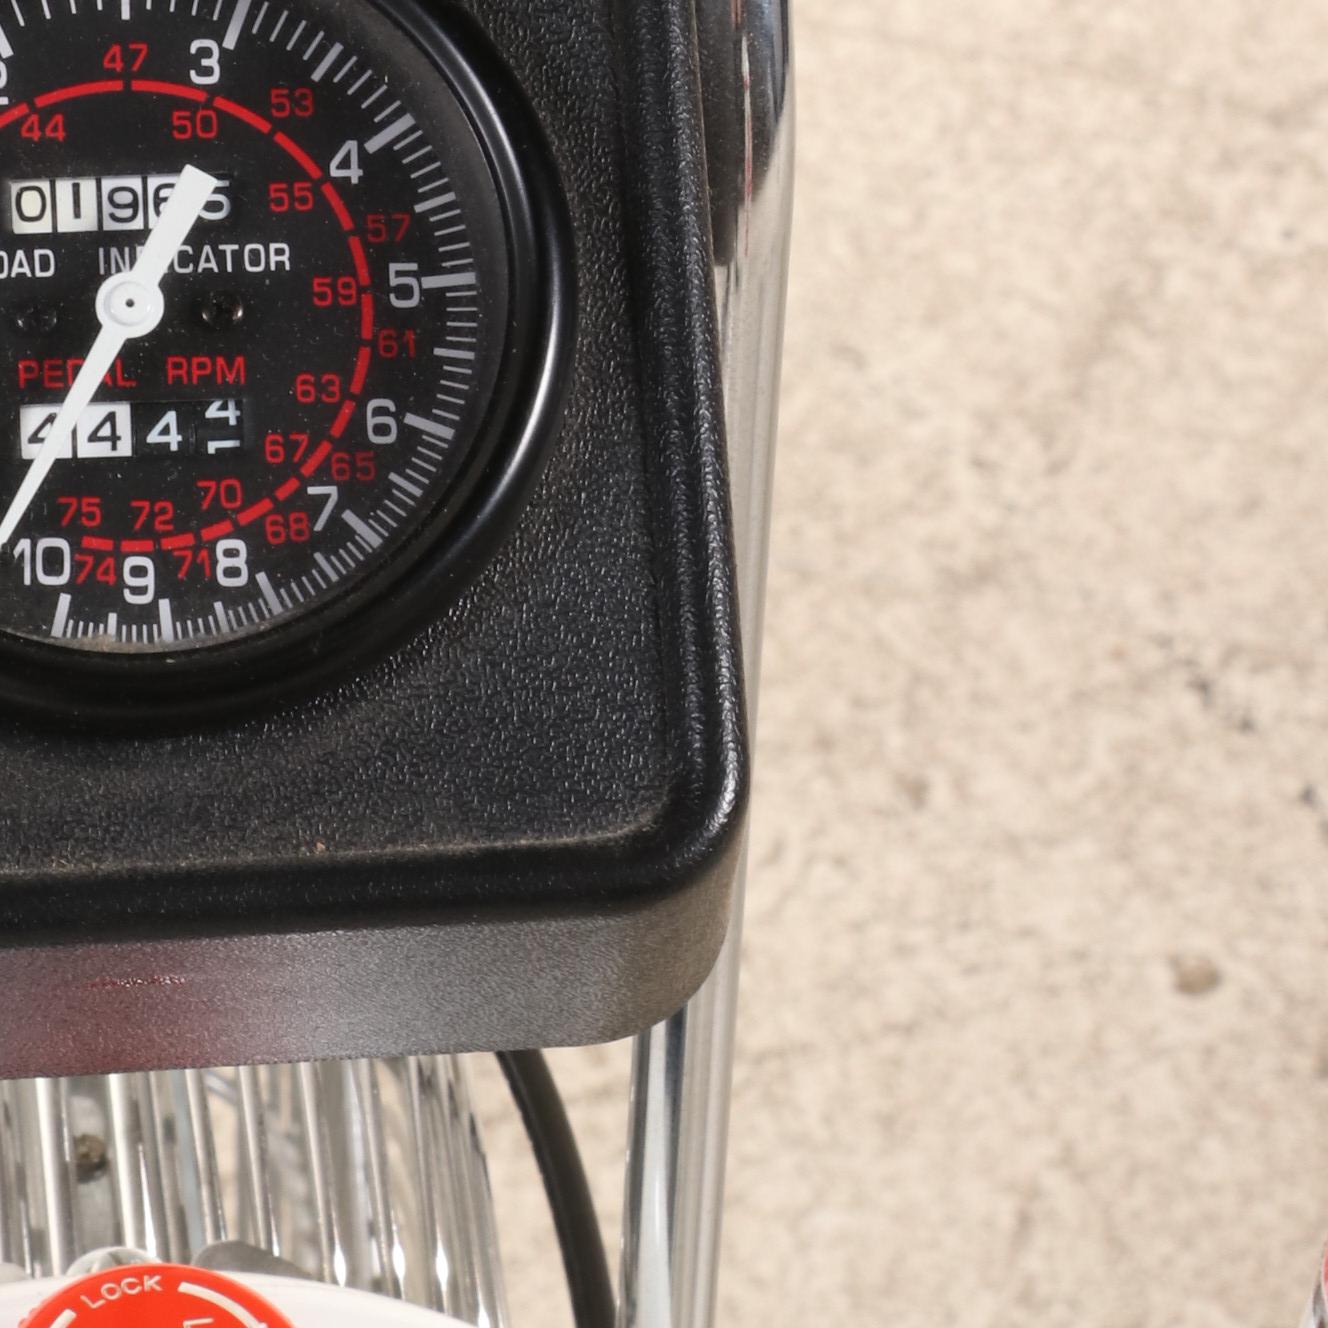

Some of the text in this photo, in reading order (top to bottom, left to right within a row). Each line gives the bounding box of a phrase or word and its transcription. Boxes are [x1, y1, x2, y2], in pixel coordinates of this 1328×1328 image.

[103, 43, 148, 72] 47
[189, 38, 220, 85] 3
[270, 88, 314, 118] 53
[20, 114, 66, 142] 44
[172, 110, 218, 140] 50
[329, 140, 364, 185] 4
[268, 182, 314, 212] 55
[366, 213, 411, 243] 57
[98, 243, 291, 275] INCATOR
[312, 276, 358, 306] 59
[389, 262, 421, 309] 5
[378, 329, 416, 359] 61
[17, 355, 246, 389] PEL RPM
[295, 374, 341, 403] 63
[366, 398, 398, 445] 6
[264, 433, 309, 463] 67
[330, 451, 377, 481] 65
[197, 478, 243, 509] 70
[307, 486, 339, 532] 7
[57, 496, 102, 526] 75
[130, 500, 174, 531] 72
[264, 511, 310, 545] 68
[13, 537, 72, 586] 10
[74, 554, 118, 585] 74
[173, 548, 212, 579] 71
[215, 538, 249, 588] 8
[122, 556, 156, 605] 9
[80, 1275, 163, 1310] LOCK
